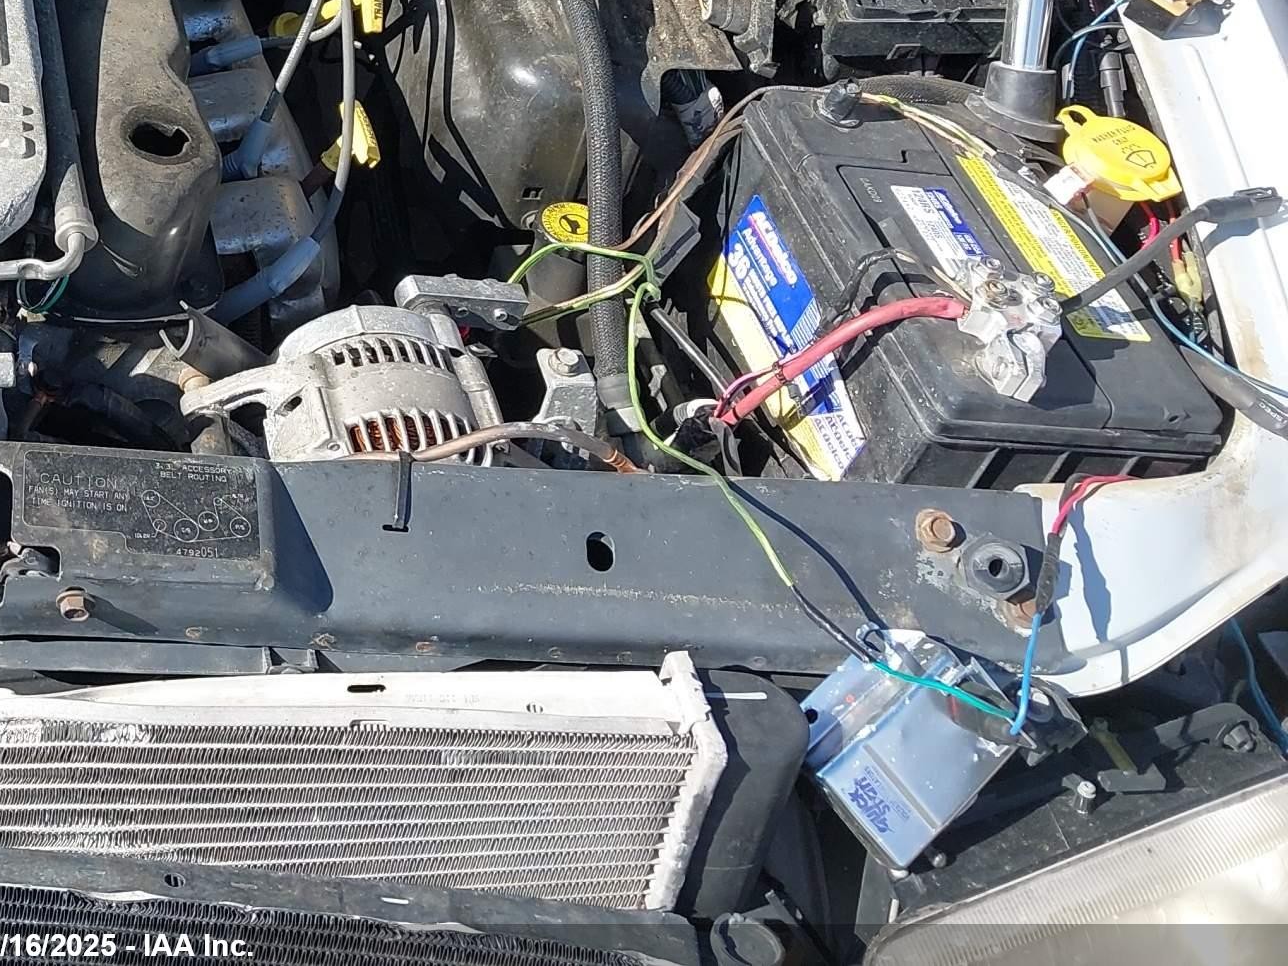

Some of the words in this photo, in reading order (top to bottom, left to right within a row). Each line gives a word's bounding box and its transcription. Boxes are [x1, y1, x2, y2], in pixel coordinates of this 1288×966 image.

[739, 227, 781, 288] Advantage
[182, 464, 231, 474] ACCESSORY
[40, 472, 117, 490] CAUTION
[160, 471, 182, 480] BELT
[187, 473, 227, 483] ROUTING
[28, 485, 59, 496] FAN(S)
[64, 488, 80, 497] MAY
[84, 489, 109, 499] START
[114, 492, 130, 501] ANY
[57, 499, 97, 510] IGNITION
[103, 502, 112, 511] IS
[175, 546, 219, 558] 4792051
